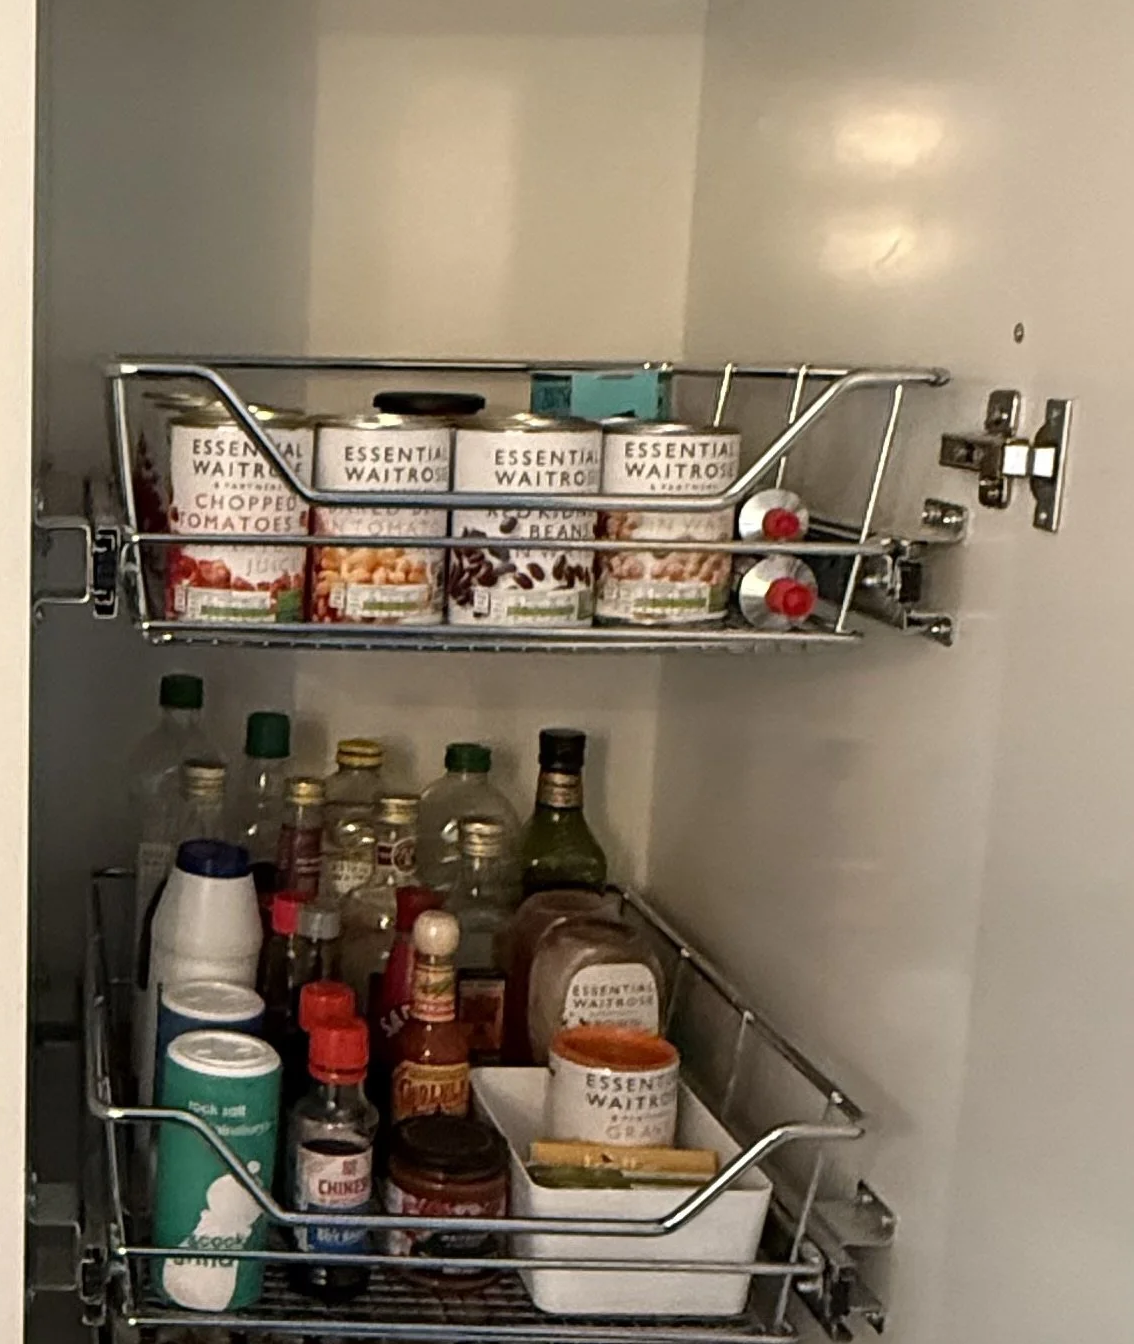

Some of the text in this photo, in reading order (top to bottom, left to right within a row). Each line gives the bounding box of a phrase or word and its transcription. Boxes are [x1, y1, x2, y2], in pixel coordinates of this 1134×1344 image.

[623, 441, 735, 458] ESSENTIAL
[623, 463, 735, 480] WAITROSE
[195, 493, 298, 512] CHOPPED
[179, 511, 293, 533] TOMATOES
